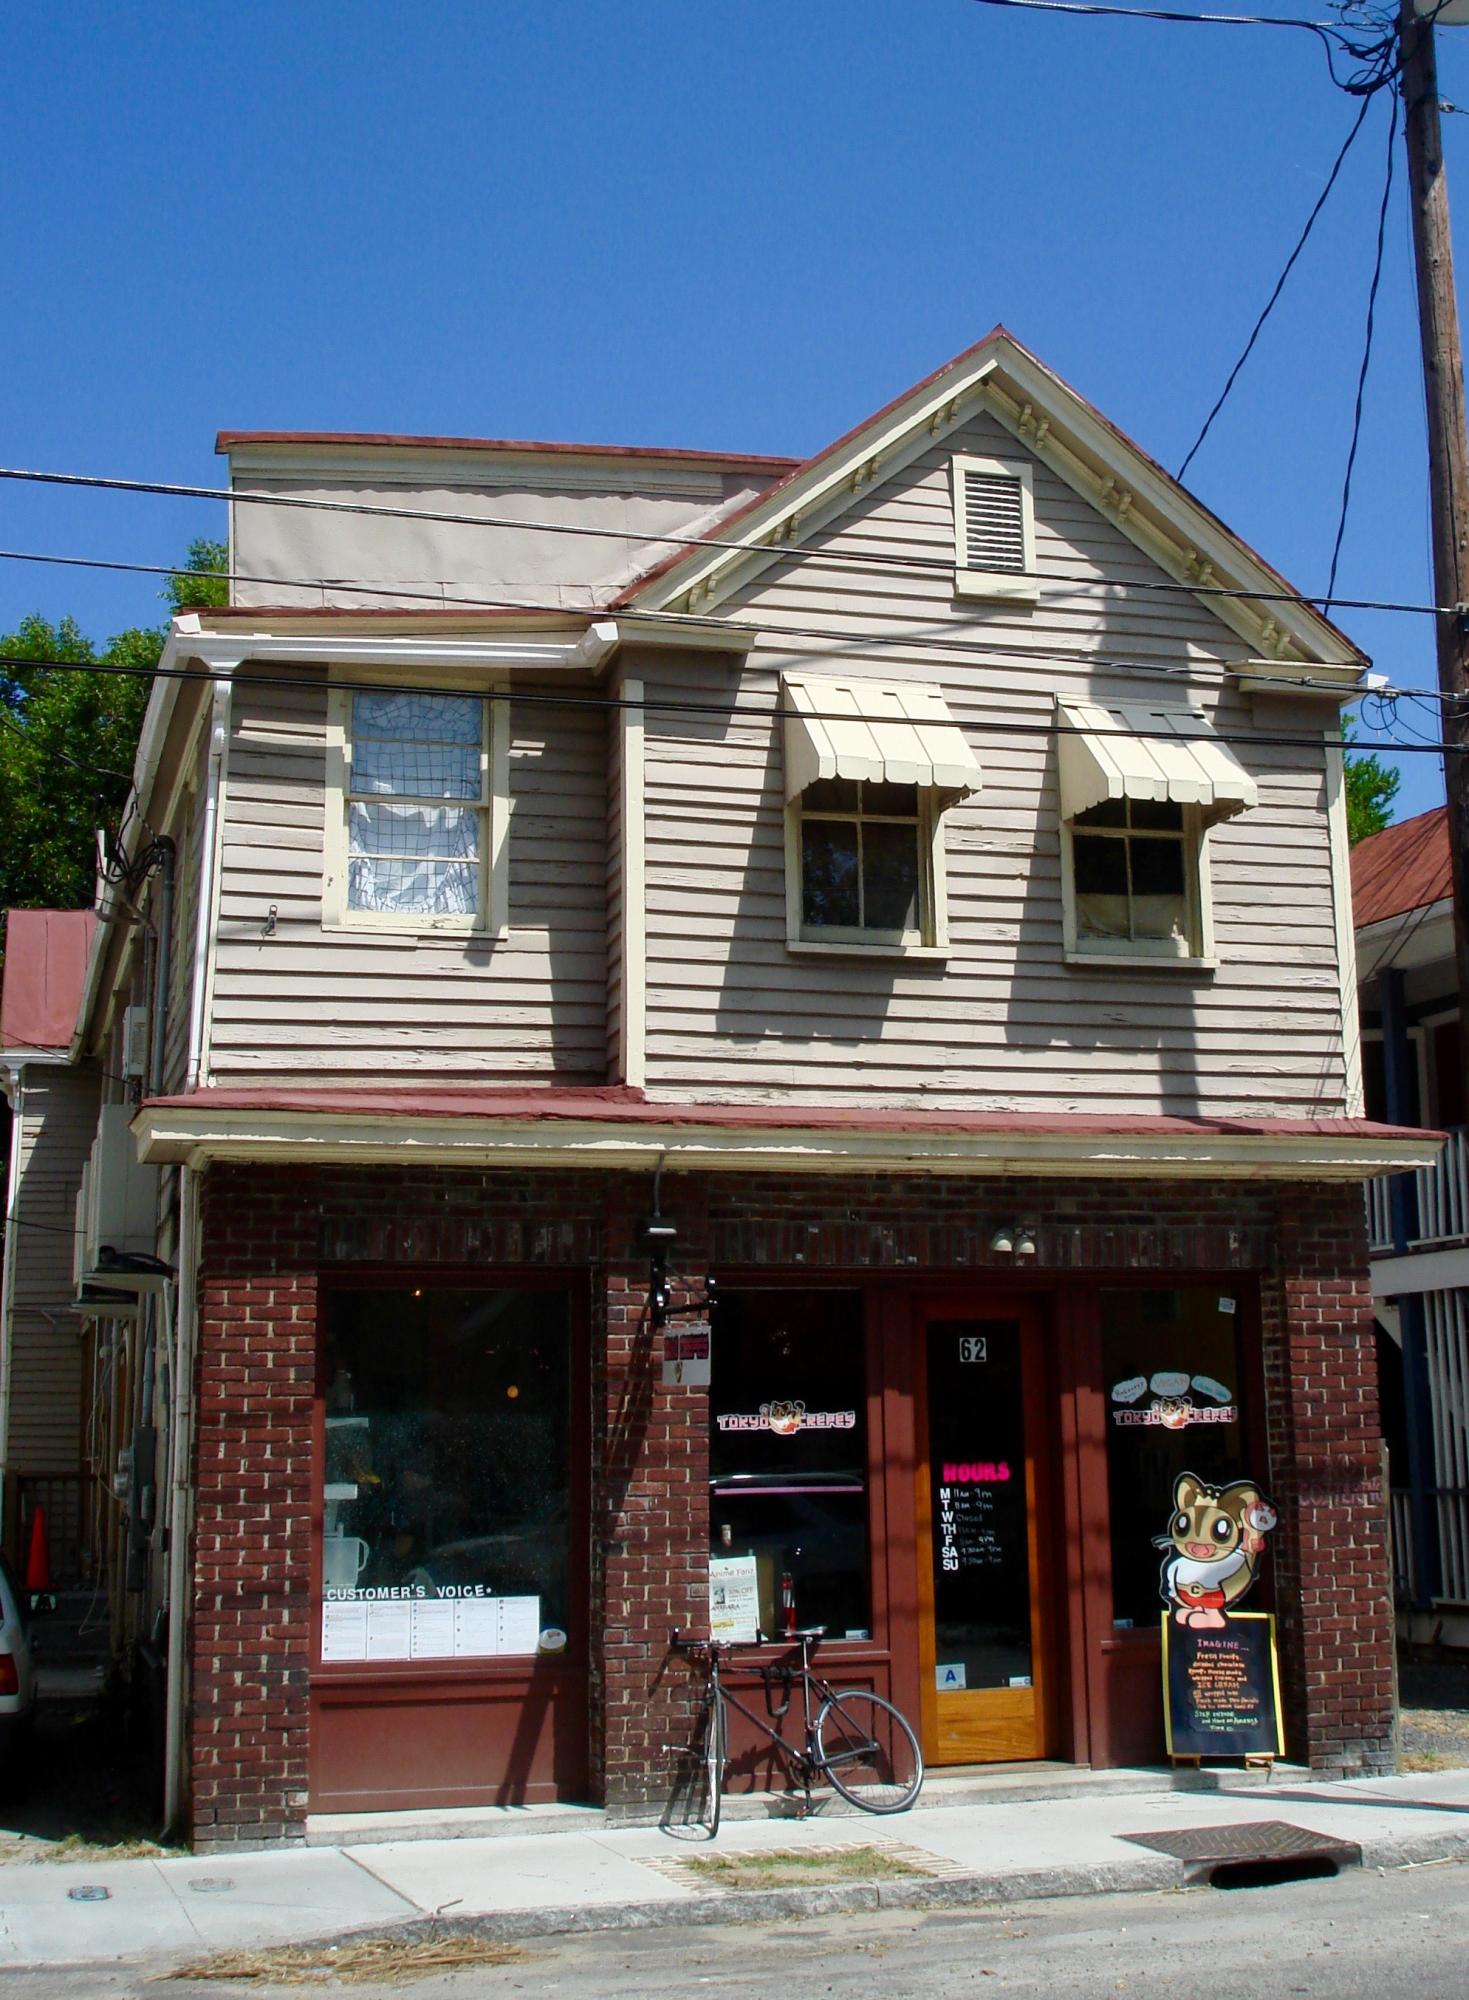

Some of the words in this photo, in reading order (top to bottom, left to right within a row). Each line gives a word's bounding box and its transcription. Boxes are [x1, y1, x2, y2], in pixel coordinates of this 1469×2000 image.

[961, 1338, 985, 1361] 62
[717, 1414, 770, 1430] TOKYO
[799, 1411, 855, 1429] CREPES
[1113, 1409, 1161, 1425] TOKYO
[943, 1462, 1010, 1482] HOURS
[940, 1488, 951, 1499] M
[941, 1500, 950, 1510] T
[942, 1511, 953, 1522] W
[941, 1523, 956, 1534] TH
[945, 1535, 953, 1546] F
[942, 1546, 958, 1558] SA
[943, 1558, 958, 1570] SU
[327, 1584, 426, 1600] CUSTOMER'S
[436, 1585, 484, 1598] VOICE
[1197, 1639, 1239, 1650] IMAGINE
[945, 1669, 957, 1682] A
